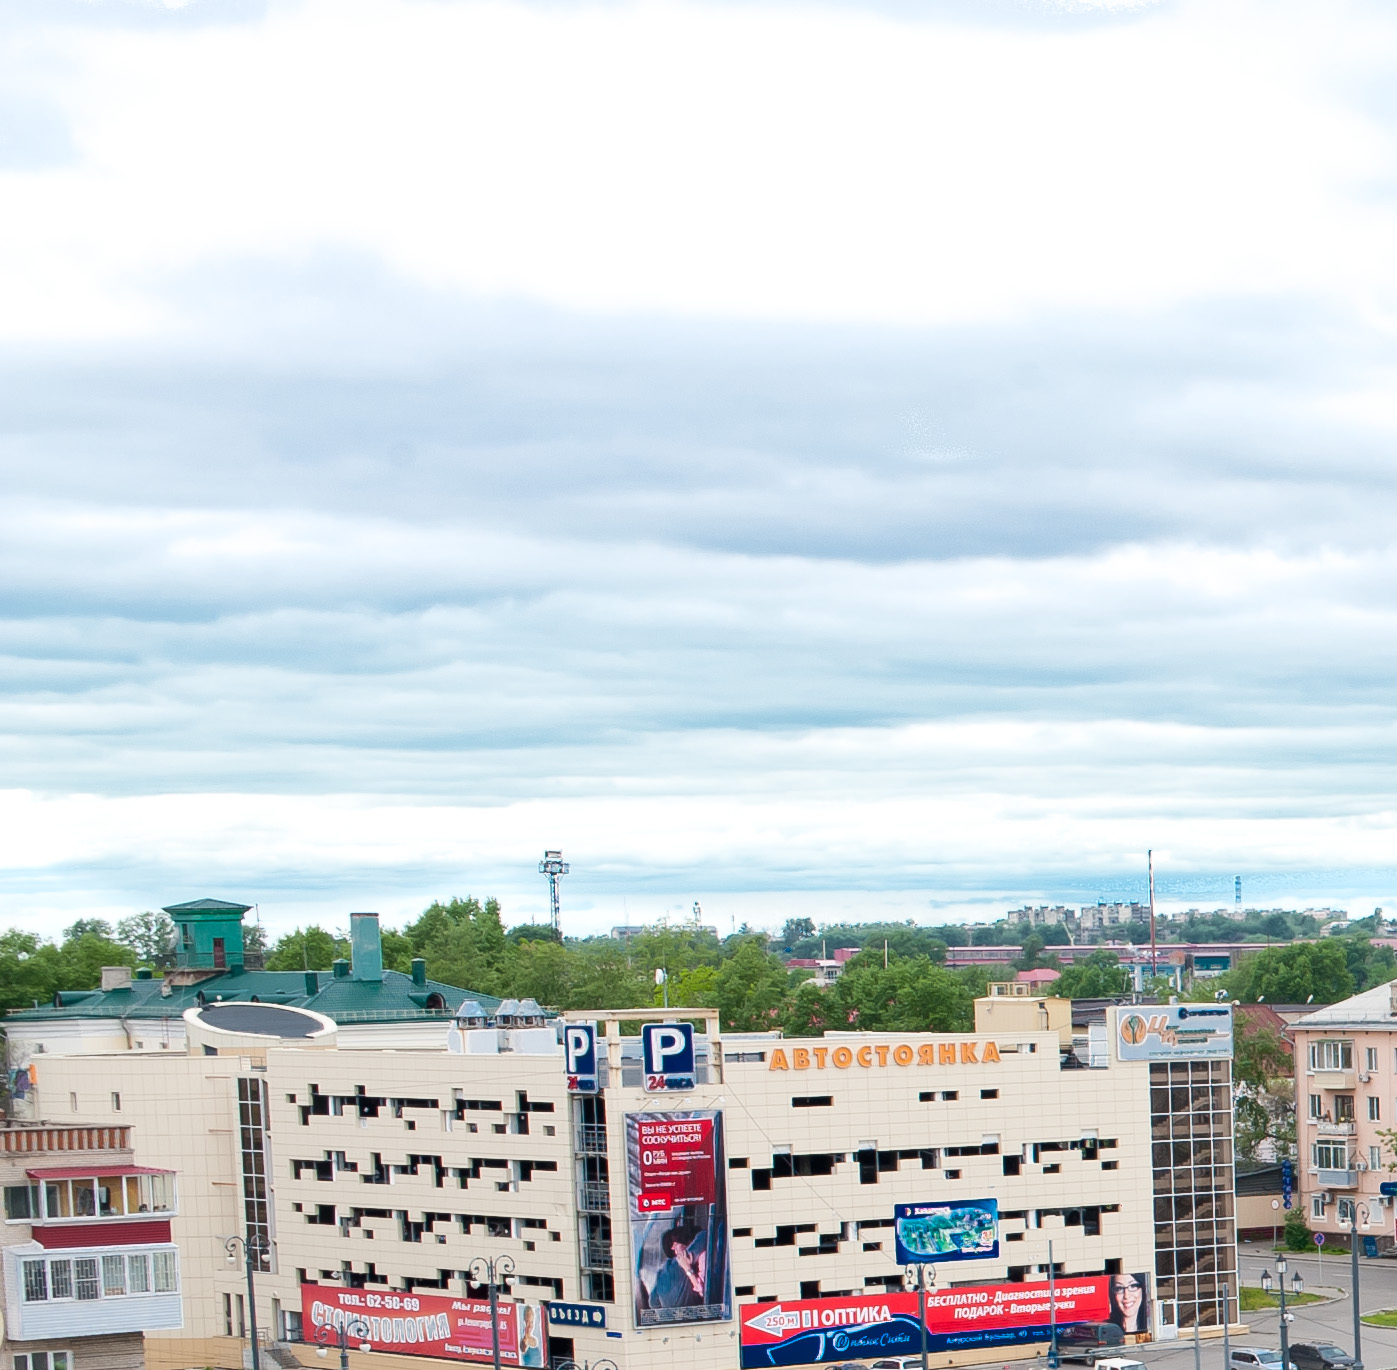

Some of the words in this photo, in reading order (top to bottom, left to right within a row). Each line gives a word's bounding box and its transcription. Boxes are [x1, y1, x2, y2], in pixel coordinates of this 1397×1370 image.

[769, 1041, 1001, 1071] АВТОСТОЯНКА
[648, 1075, 666, 1090] 24
[642, 1126, 655, 1135] ВЫ
[656, 1125, 668, 1134] НЕ
[669, 1123, 702, 1133] УСПЕЕТЕ
[642, 1134, 702, 1144] СОСКУЧИТЬСЯ!
[643, 1151, 652, 1165] 0
[927, 1292, 988, 1308] БЕСПЛАТНО
[994, 1286, 1060, 1304] Диагностиа
[1061, 1285, 1096, 1298] зрения
[452, 1301, 472, 1312] Мы
[954, 1304, 1004, 1320] ПОДАРОК
[311, 1301, 451, 1344] СТОМАТОЛОГИЯ
[551, 1308, 589, 1324] ВЪЕЗД
[766, 1315, 785, 1327] 250
[821, 1305, 892, 1326] ОПТИКА
